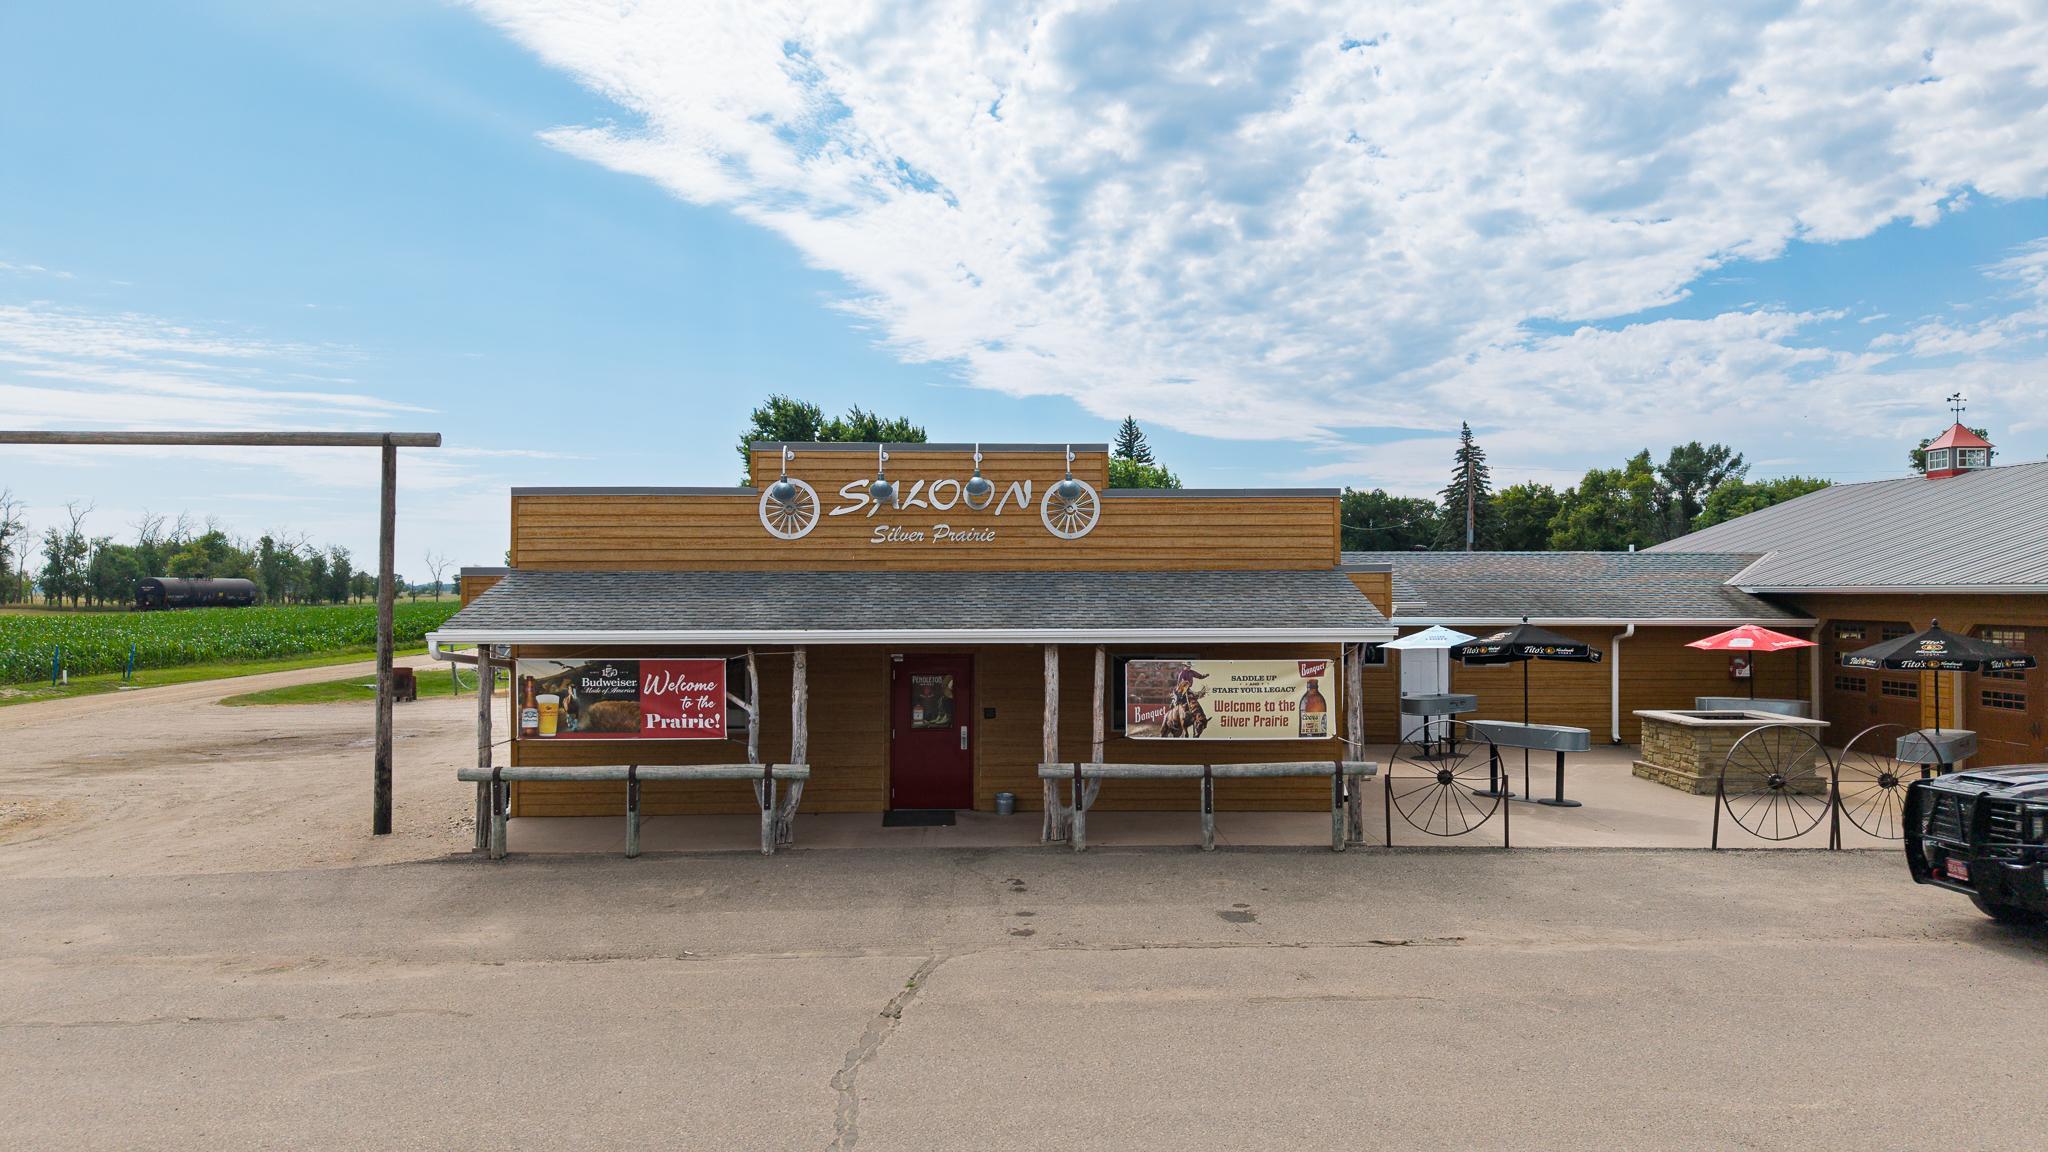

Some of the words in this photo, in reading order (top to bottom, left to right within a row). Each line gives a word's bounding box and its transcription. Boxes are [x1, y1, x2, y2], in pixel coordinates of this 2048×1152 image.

[870, 525, 925, 544] Silver
[932, 523, 996, 544] Prairie
[1462, 646, 1480, 654] Tito's
[1524, 645, 1545, 654] Tito's
[1301, 663, 1325, 677] Banquet
[1901, 660, 1926, 668] Tito's
[581, 677, 637, 687] Budweiser
[643, 669, 718, 696] Welcome
[679, 695, 694, 711] to
[695, 694, 716, 711] the
[1214, 700, 1261, 712] Welcome
[1264, 700, 1276, 712] to
[1278, 700, 1296, 712] the
[644, 713, 721, 729] Prairie!
[1134, 706, 1167, 723] Banquet
[1220, 715, 1251, 728] Silver
[1253, 715, 1289, 728] Prairie
